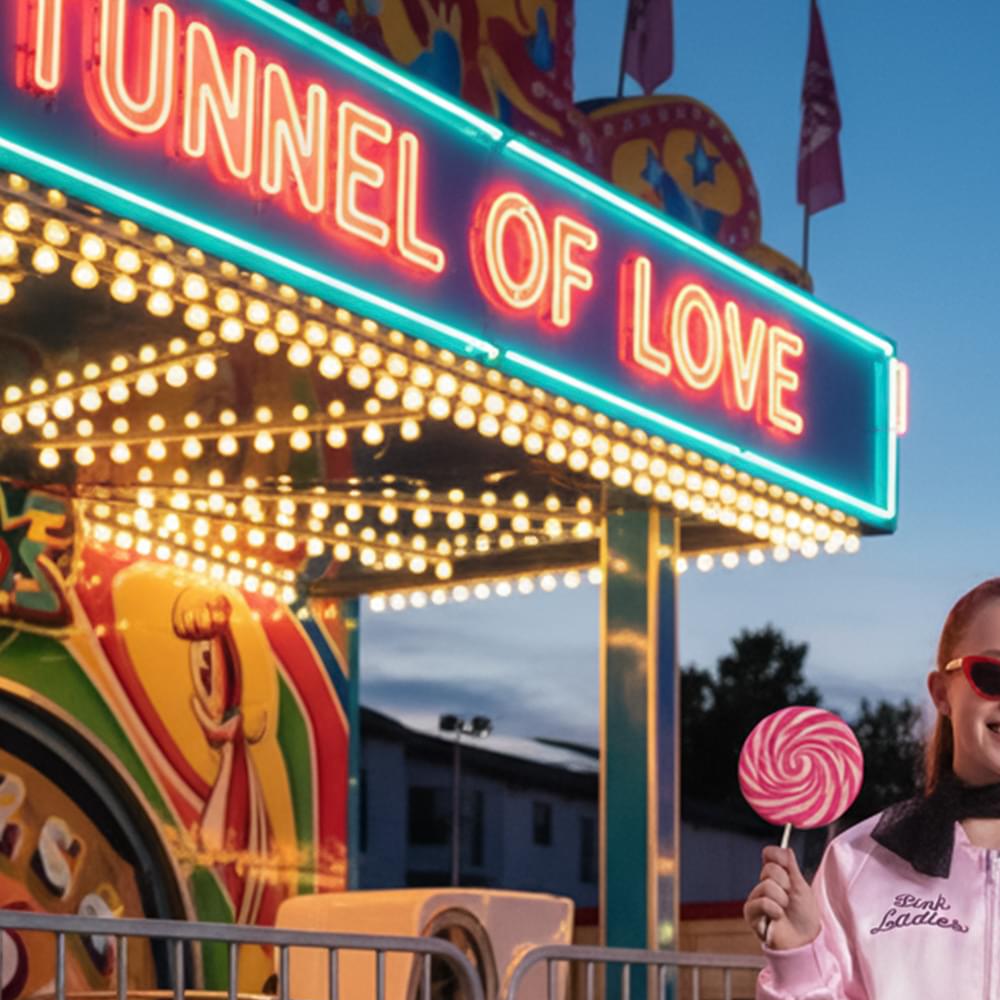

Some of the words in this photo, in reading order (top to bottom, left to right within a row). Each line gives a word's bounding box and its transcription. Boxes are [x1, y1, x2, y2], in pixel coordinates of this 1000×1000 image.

[482, 190, 599, 328] OF
[631, 255, 804, 435] LOVE
[893, 893, 951, 911] Pink
[870, 908, 969, 935] Ladies
